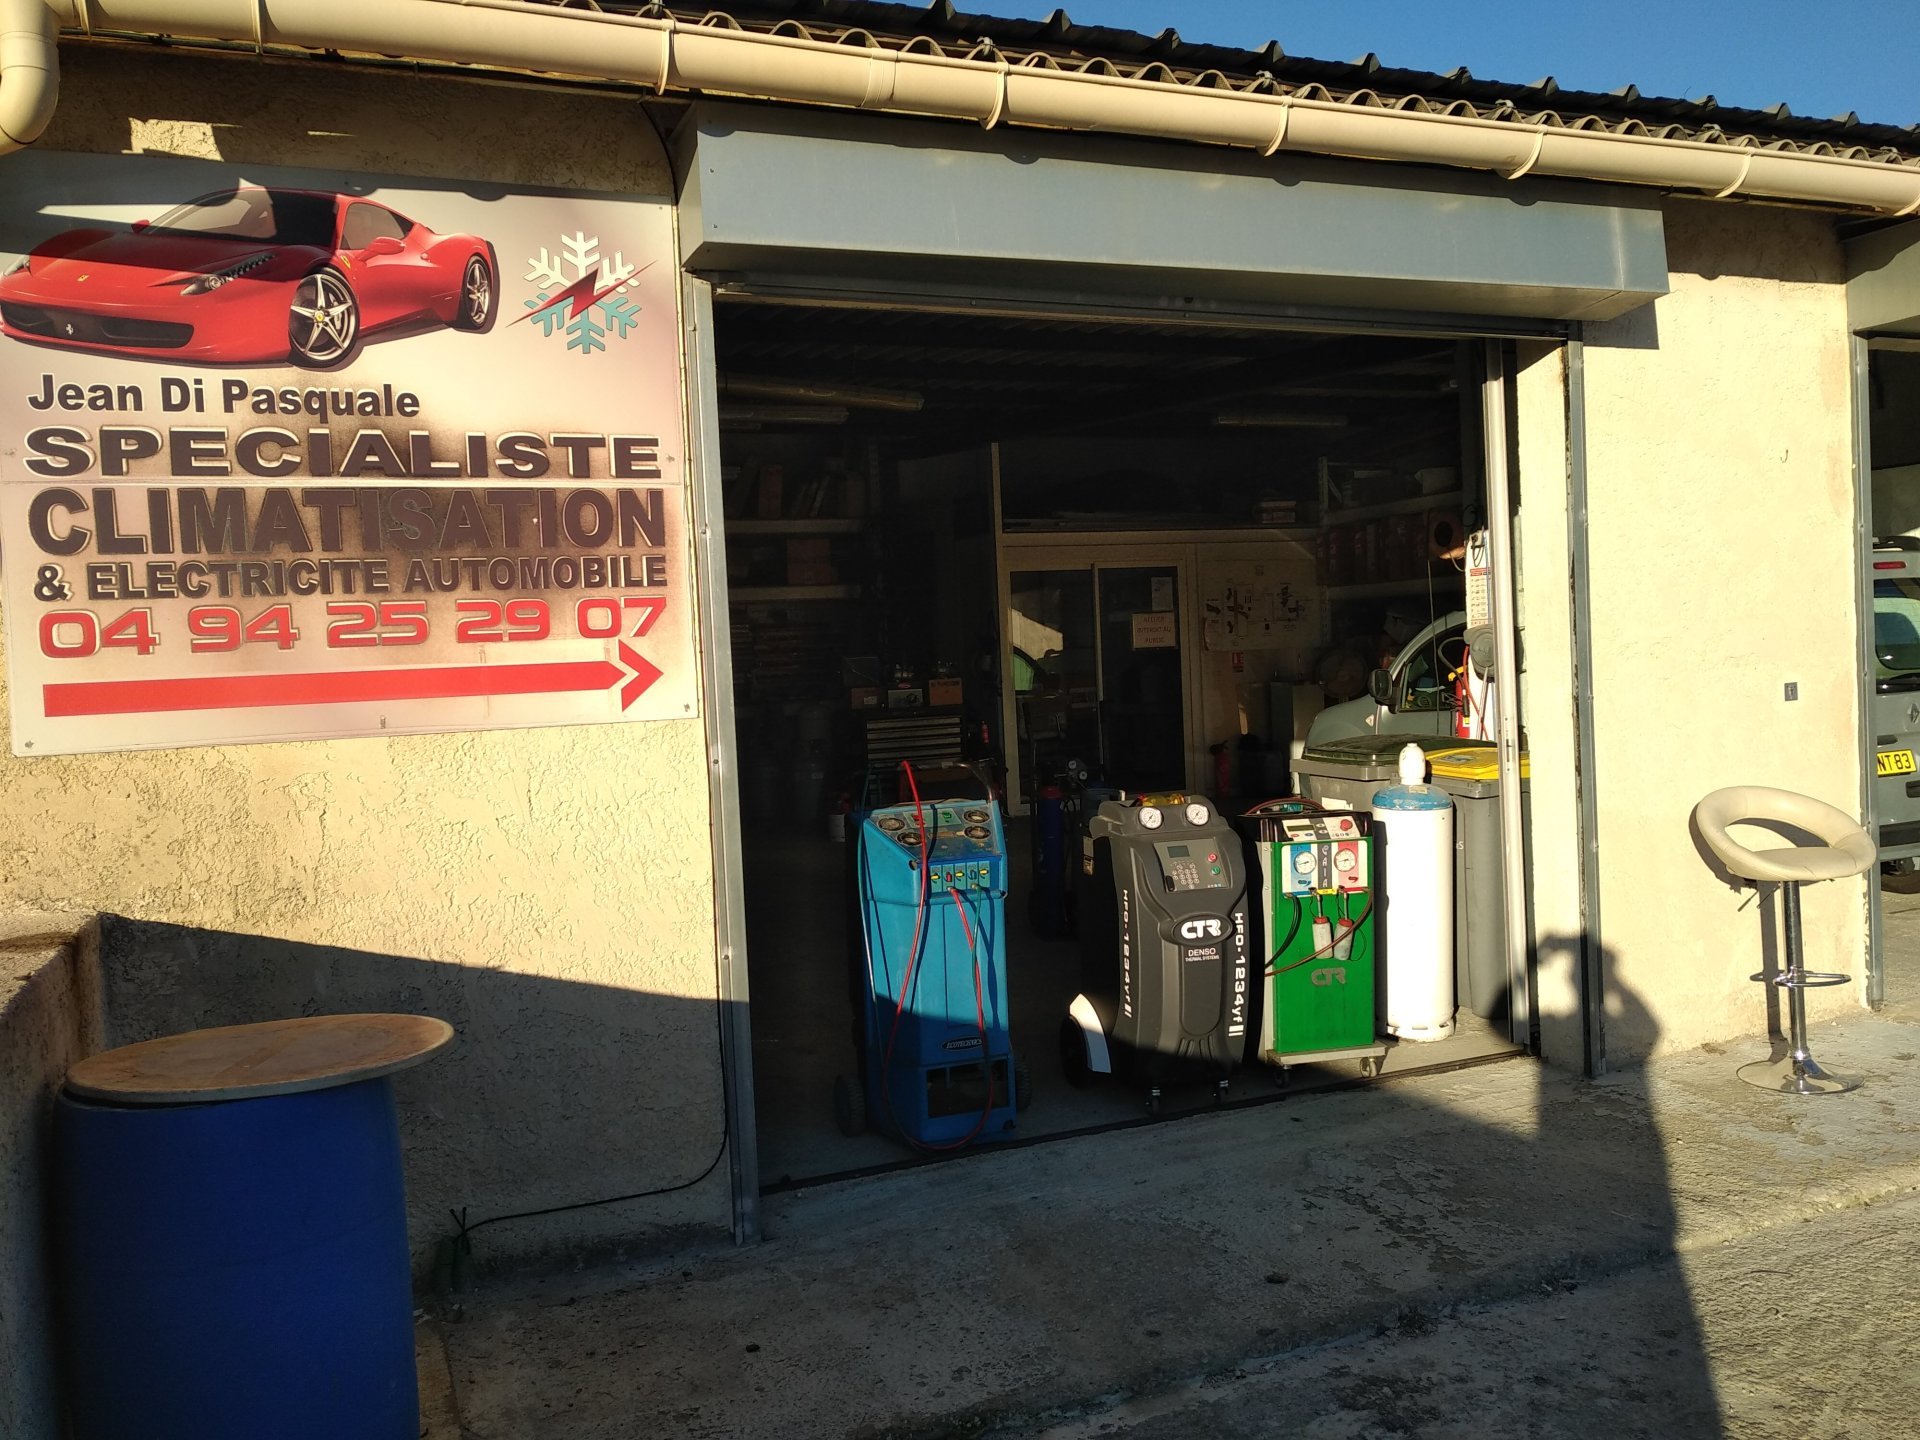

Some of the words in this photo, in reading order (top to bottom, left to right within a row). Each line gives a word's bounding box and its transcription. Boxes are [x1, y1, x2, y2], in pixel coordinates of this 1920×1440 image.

[26, 373, 144, 412] Jean
[159, 376, 206, 413] Di
[222, 378, 421, 423] Pasquale
[23, 424, 662, 479] SPECIALISTE
[27, 487, 666, 556] CLIMATISATION
[33, 562, 73, 602] &
[87, 558, 391, 600] ELECTRICITE
[402, 555, 668, 593] AUTOMOBILE
[38, 606, 161, 659] 04
[187, 602, 301, 654] 94
[326, 599, 431, 648] 25
[455, 597, 551, 644] 29
[574, 594, 667, 640] 07
[1894, 753, 1911, 769] 83
[1180, 918, 1222, 940] CTR
[1188, 947, 1217, 957] DENSO
